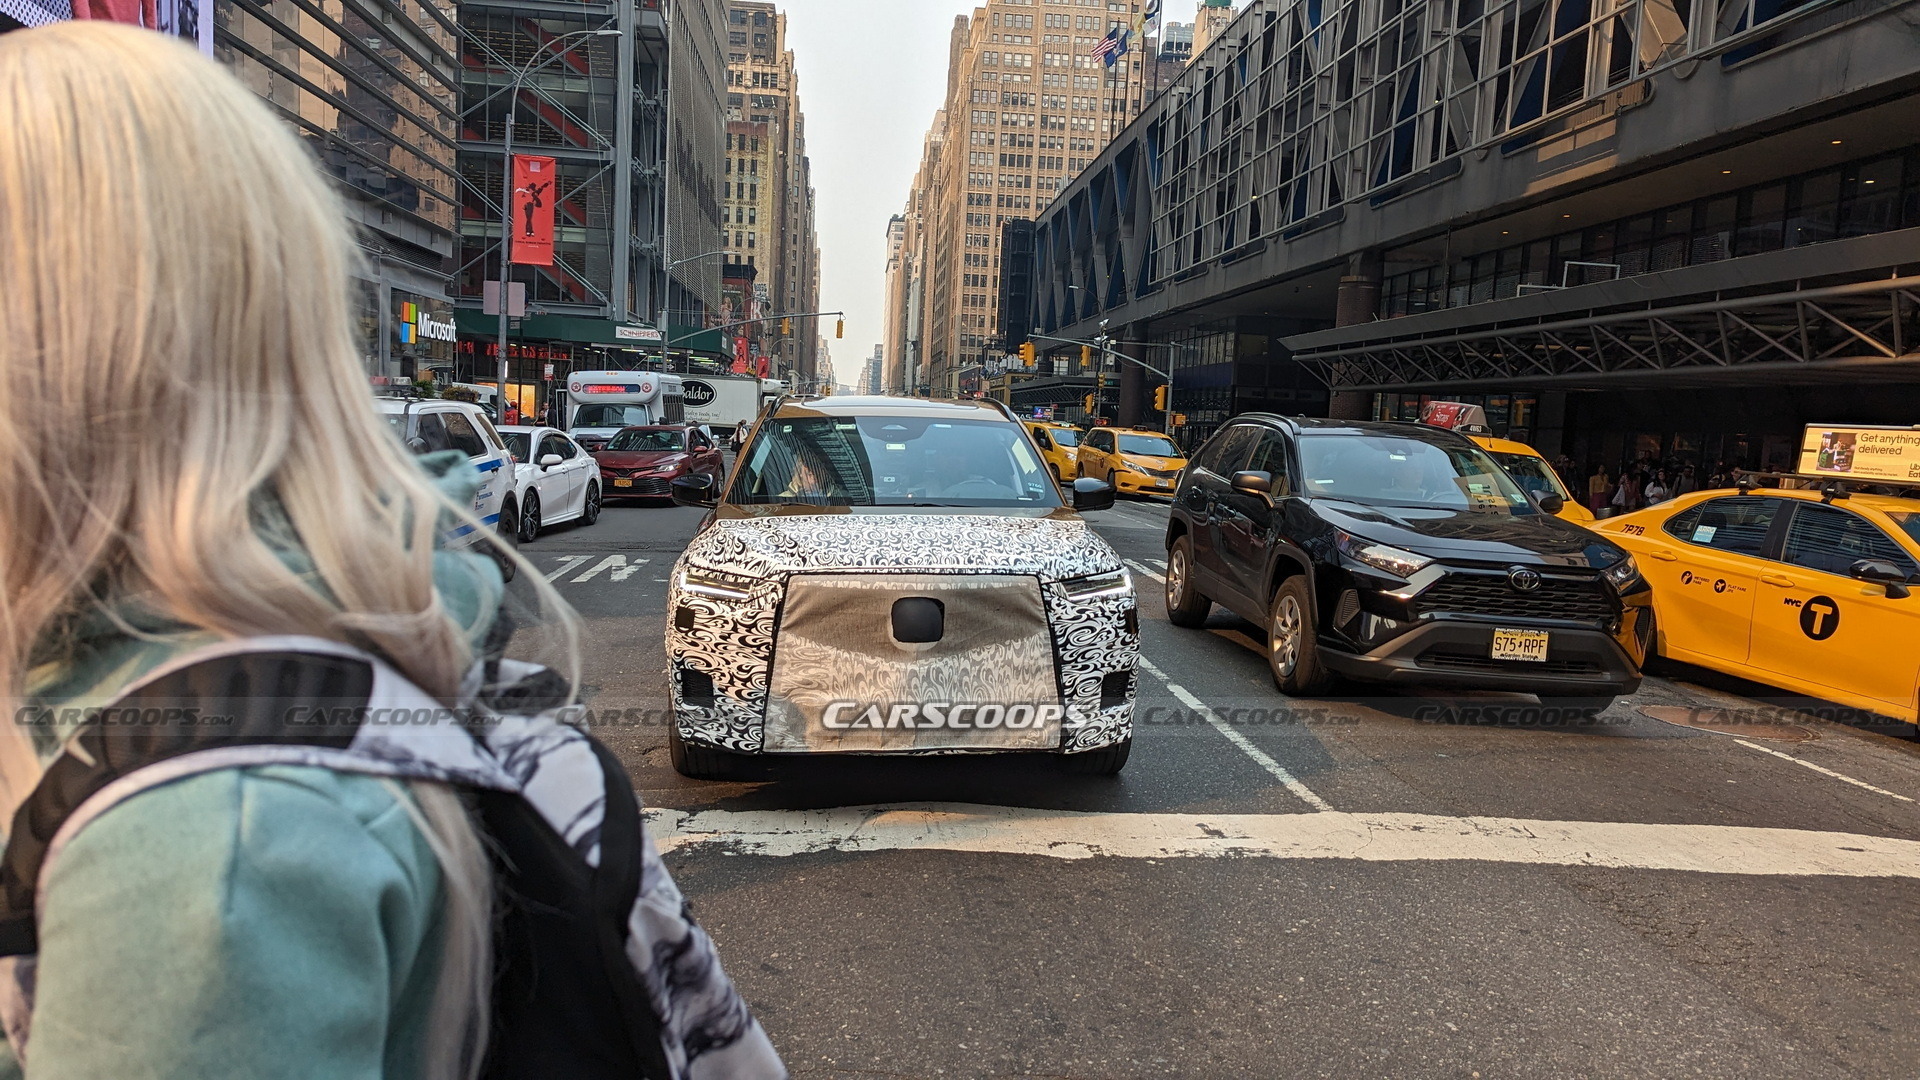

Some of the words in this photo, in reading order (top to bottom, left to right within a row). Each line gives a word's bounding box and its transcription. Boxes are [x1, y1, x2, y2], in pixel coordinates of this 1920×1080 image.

[418, 311, 457, 342] Microsoft
[1860, 433, 1878, 442] Get
[1879, 434, 1920, 447] anything
[1858, 444, 1903, 455] delivered
[1620, 524, 1646, 536] 7P78
[1783, 597, 1802, 607] NYC
[1810, 603, 1833, 635] T
[1494, 637, 1516, 652] S75
[1523, 638, 1546, 654] RPF
